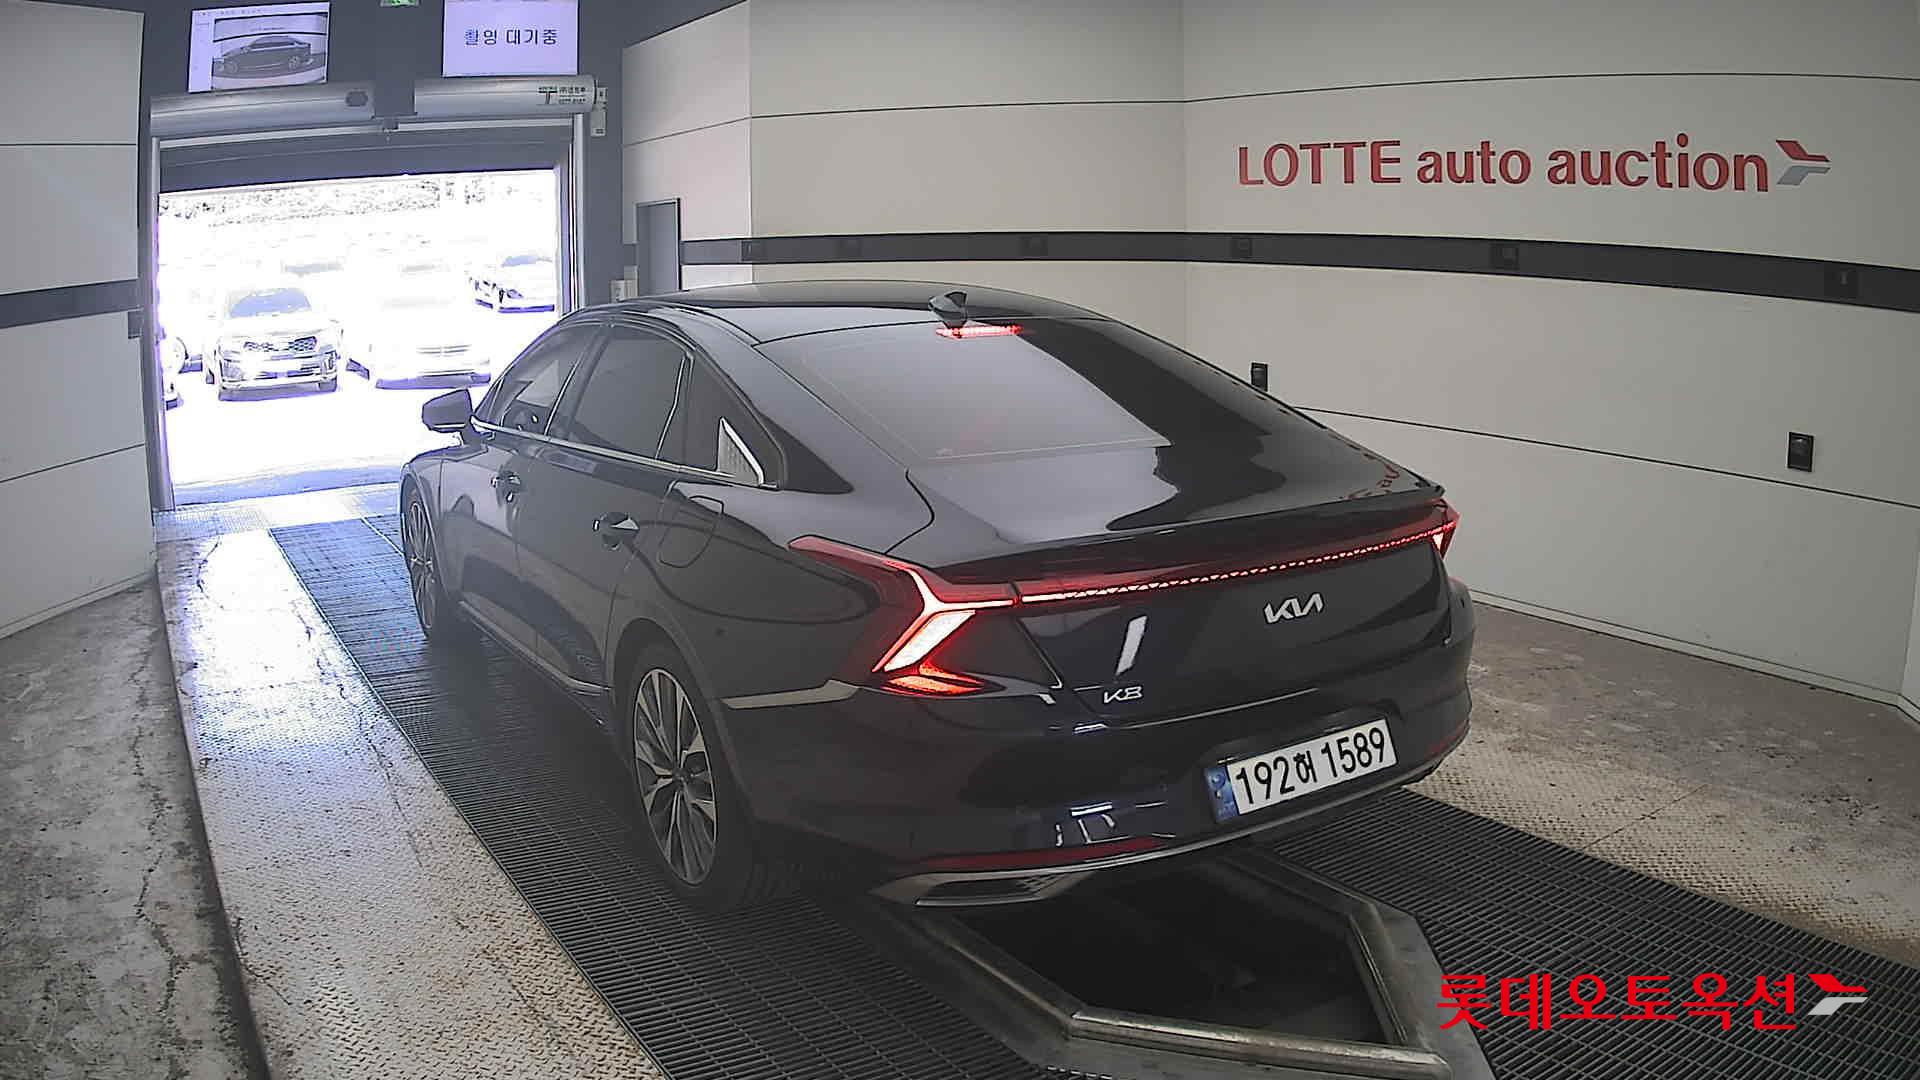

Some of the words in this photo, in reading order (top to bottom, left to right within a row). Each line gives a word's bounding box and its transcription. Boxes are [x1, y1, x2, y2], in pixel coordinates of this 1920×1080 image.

[506, 28, 558, 46] 대기중
[1239, 139, 1402, 187] LOTTE
[1416, 140, 1532, 186] auto
[1546, 132, 1770, 193] auction
[1263, 592, 1324, 625] KIA
[1103, 685, 1144, 704] K8
[1235, 750, 1318, 805] 192허
[1320, 727, 1386, 779] 1589
